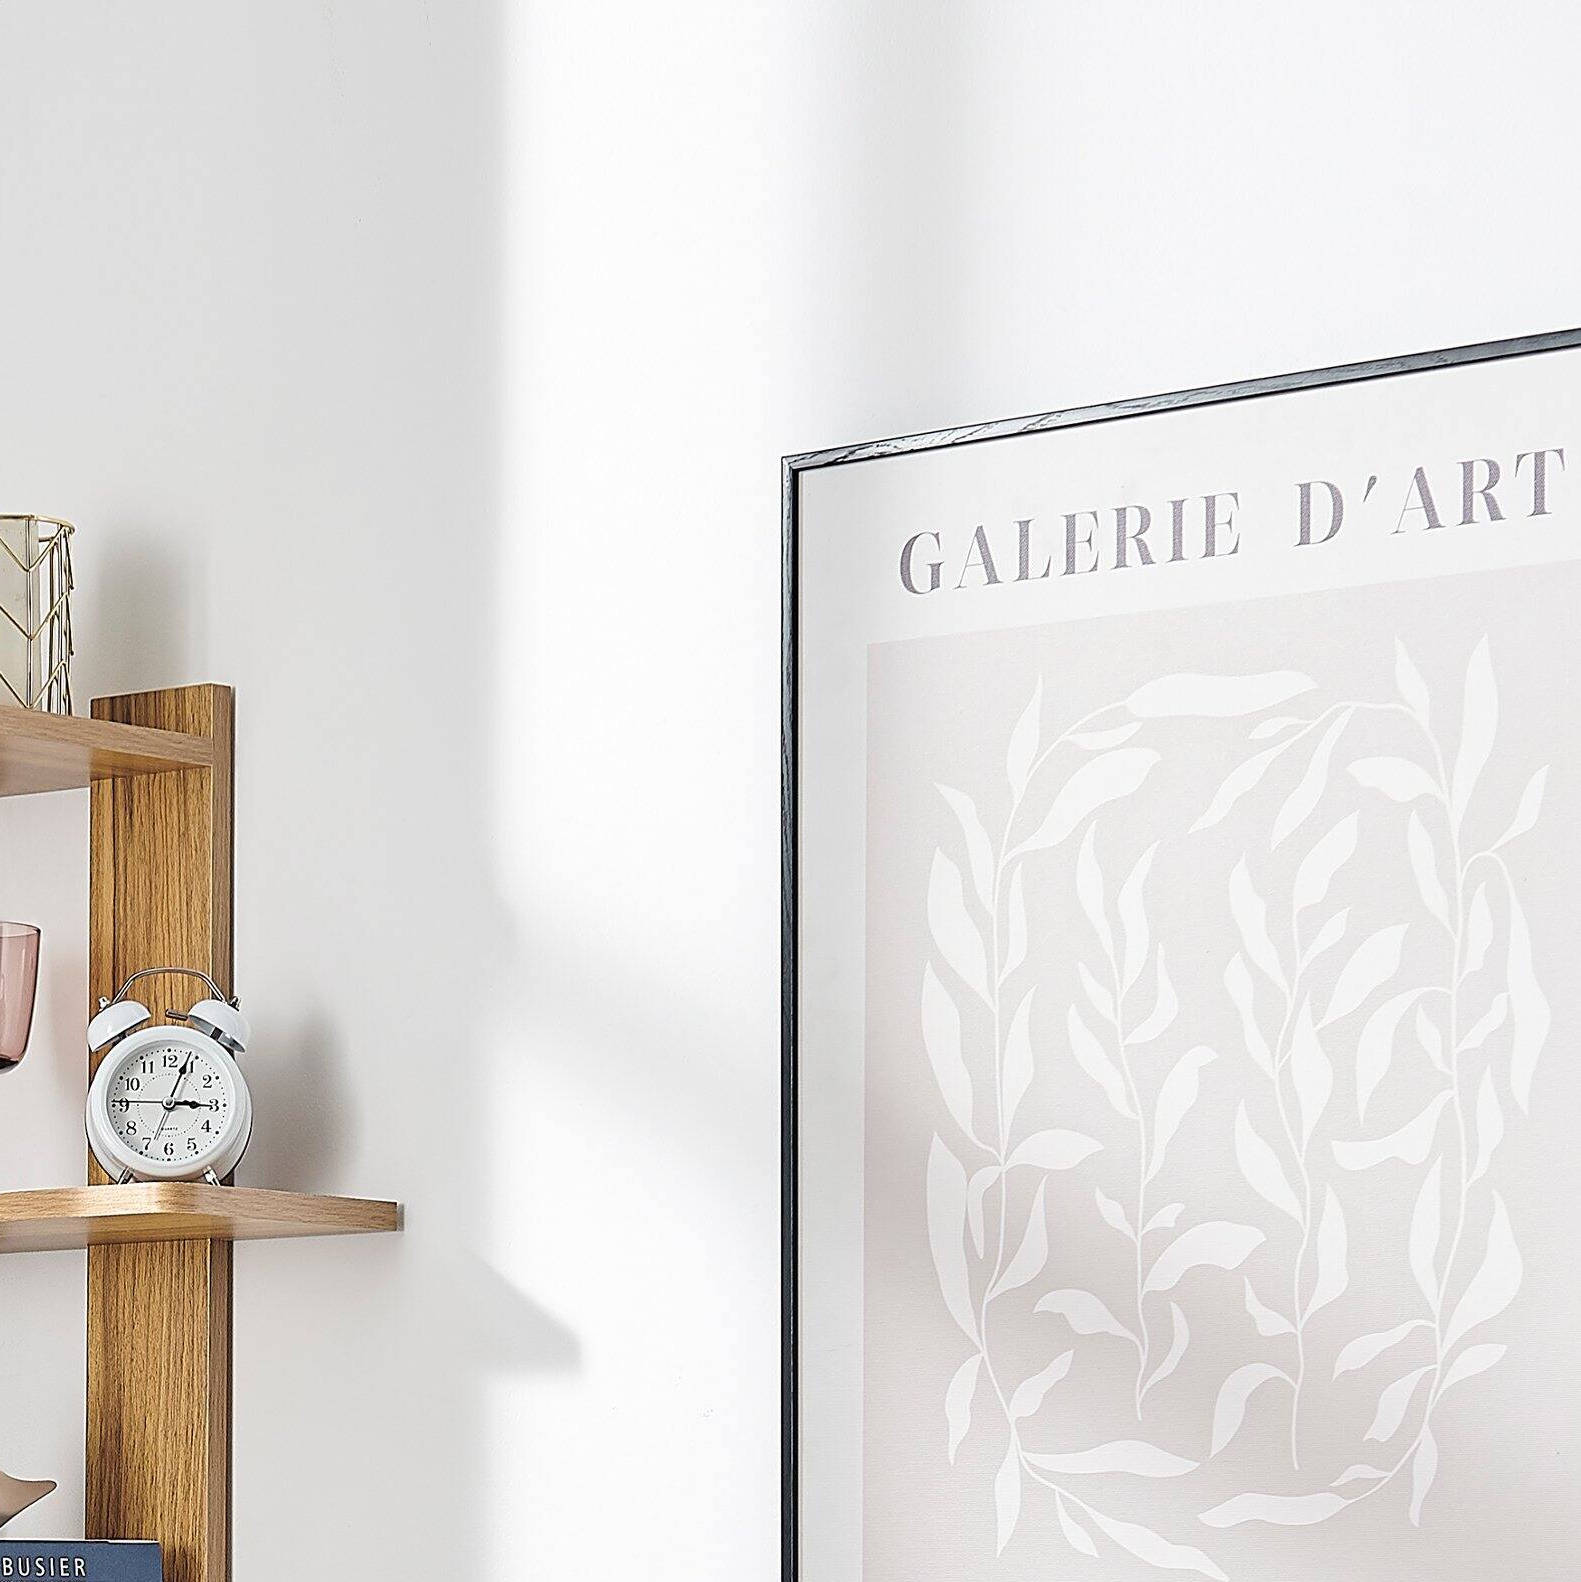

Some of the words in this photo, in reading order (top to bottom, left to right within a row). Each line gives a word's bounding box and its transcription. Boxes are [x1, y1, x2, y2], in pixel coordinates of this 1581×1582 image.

[898, 491, 1241, 596] GALERIE
[1293, 448, 1565, 550] D'ART
[141, 1061, 154, 1073] 11
[163, 1055, 178, 1067] 12
[125, 1078, 140, 1091] 10
[202, 1075, 212, 1088] 2
[119, 1098, 129, 1112] 9
[209, 1098, 219, 1112] 3
[126, 1121, 137, 1135] 8
[201, 1120, 211, 1132] 4
[142, 1138, 151, 1150] 7
[164, 1143, 174, 1155] 6
[187, 1138, 197, 1151] 5
